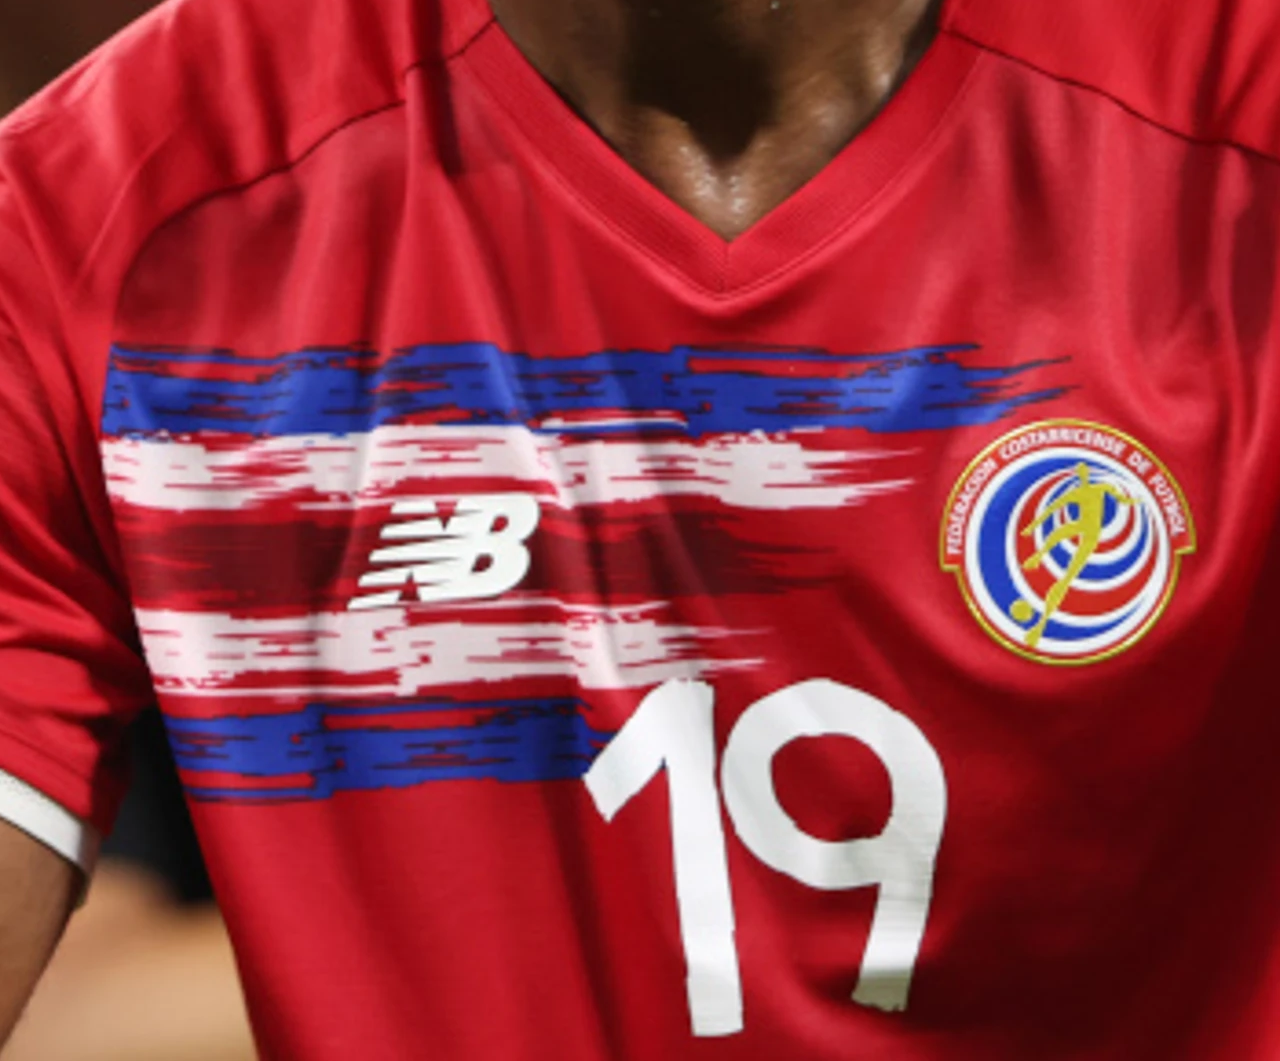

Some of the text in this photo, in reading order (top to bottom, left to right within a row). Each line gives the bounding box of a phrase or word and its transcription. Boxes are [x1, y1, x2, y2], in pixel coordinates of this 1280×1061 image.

[1126, 451, 1153, 476] DE
[347, 492, 541, 610] NB
[583, 677, 947, 1037] 19
